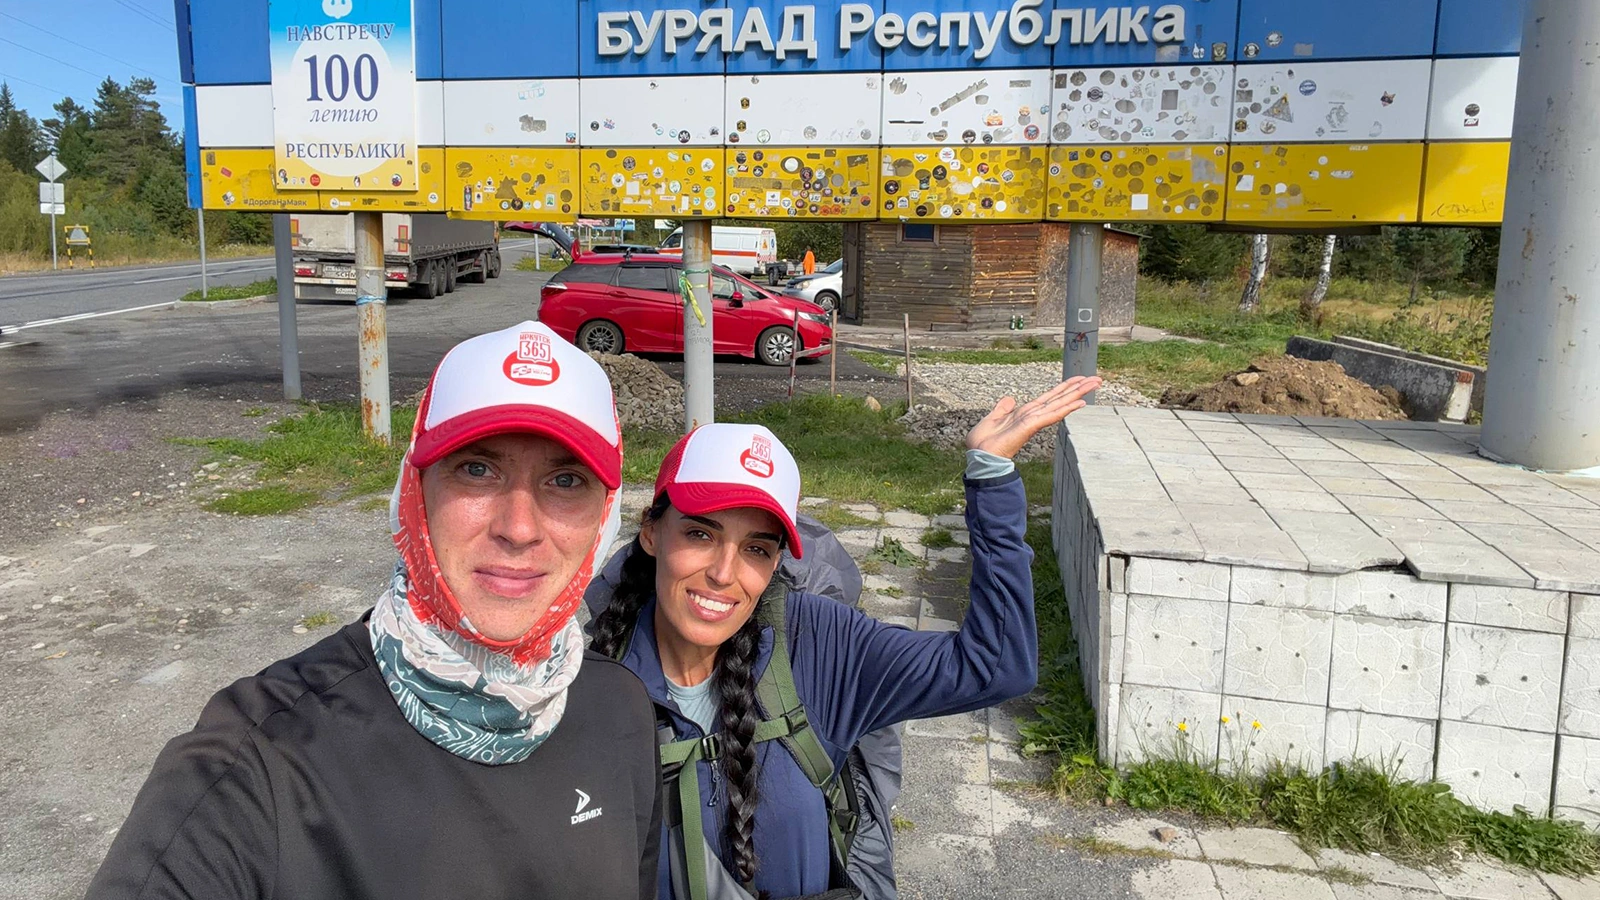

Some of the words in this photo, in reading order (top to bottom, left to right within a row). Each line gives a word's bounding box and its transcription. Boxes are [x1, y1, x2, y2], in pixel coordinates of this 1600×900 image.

[287, 23, 394, 42] НАВСТРЕЧУ
[597, 5, 818, 60] БУРЯАД
[839, 0, 1186, 60] Республика
[304, 53, 379, 102] 100
[309, 106, 379, 123] летию
[285, 142, 406, 159] РЕСПУБЛИКИ
[519, 333, 551, 344] ИРКУТСК
[523, 340, 546, 359] 365
[753, 442, 768, 458] 365
[571, 807, 602, 825] DEMIX
